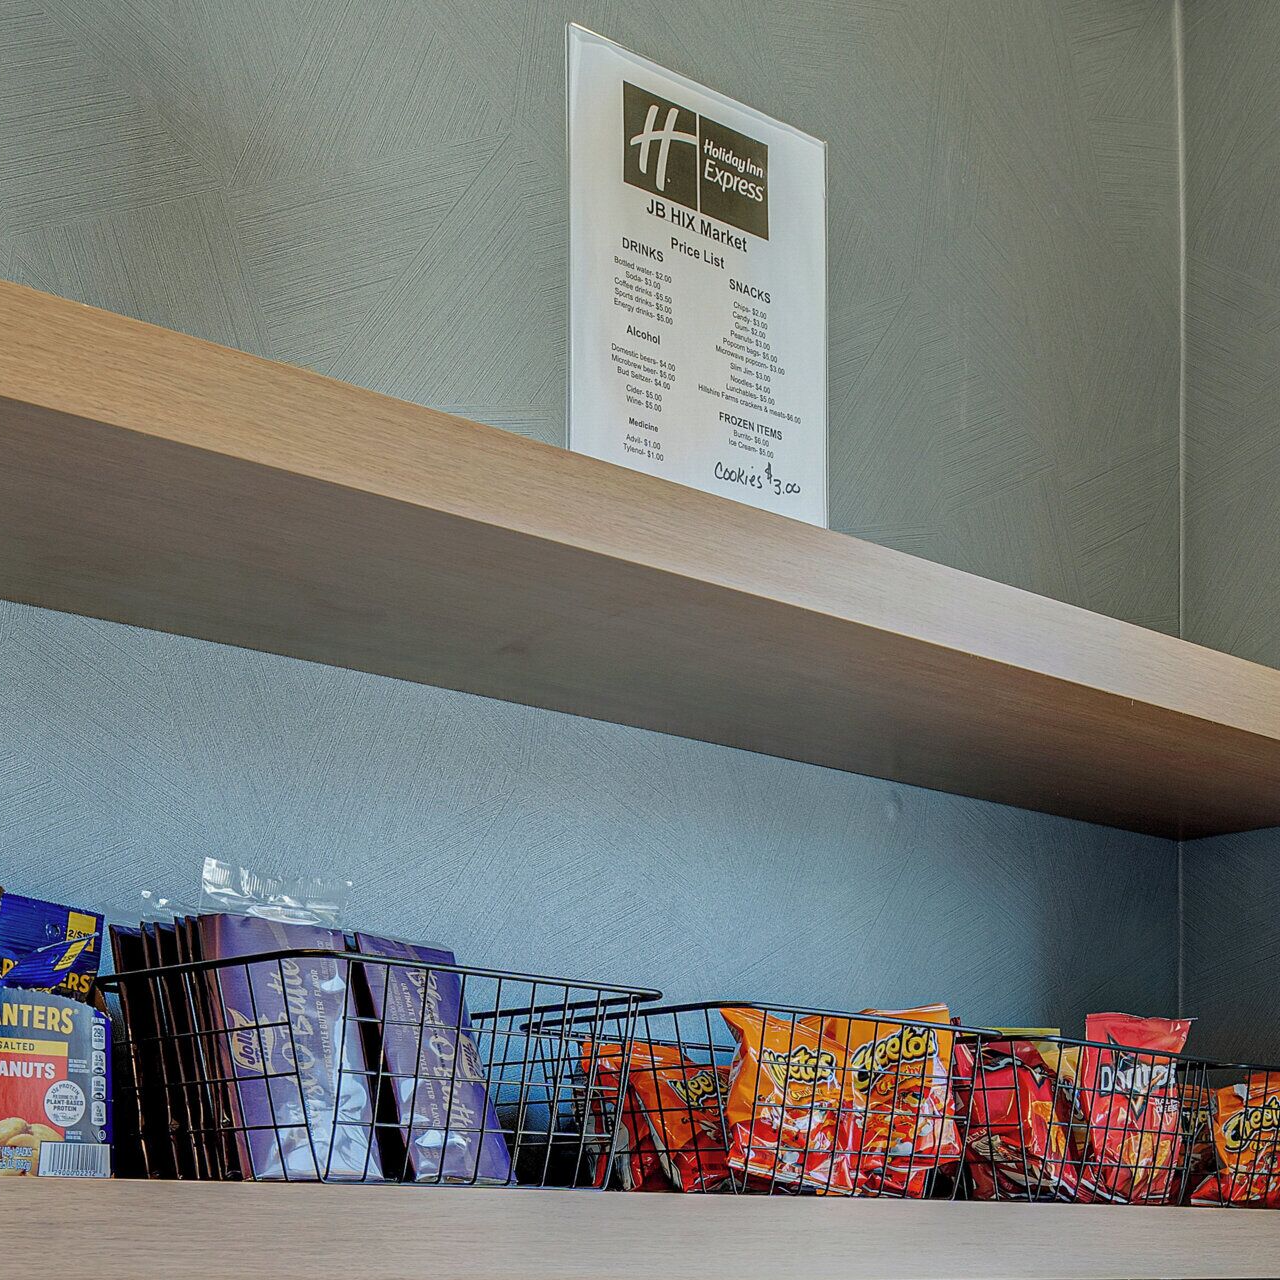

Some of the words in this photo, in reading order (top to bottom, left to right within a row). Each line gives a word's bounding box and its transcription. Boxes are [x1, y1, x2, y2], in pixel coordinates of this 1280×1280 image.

[703, 139, 746, 173] Holiday
[746, 158, 764, 178] Inn
[704, 159, 764, 201] Express
[646, 199, 665, 219] JB
[671, 207, 695, 232] HIX
[700, 219, 747, 252] Market
[622, 236, 664, 262] DRINKS
[671, 237, 700, 259] Price
[704, 250, 725, 269] List
[614, 255, 635, 270] Bottled
[655, 271, 672, 284] $2.00
[625, 271, 643, 282] Soda-
[644, 277, 661, 289] $3.00
[614, 277, 633, 290] Coffee
[635, 286, 652, 297] drinks
[729, 279, 771, 304] SNACKS
[614, 287, 634, 301] Sports
[655, 302, 672, 314] $5.00
[614, 297, 634, 313] Energy
[657, 313, 673, 325] $5.00
[752, 308, 767, 319] $2.00
[626, 324, 661, 345] Alcohol
[751, 328, 766, 339] $2.00
[753, 319, 768, 330] $3.00
[611, 342, 639, 359] Domestic
[659, 360, 676, 372] $4.00
[722, 337, 745, 352] Popcorn
[762, 352, 778, 363] $5.00
[755, 339, 770, 351] $3.00
[611, 354, 641, 370] Microbrew
[659, 370, 676, 381] $5.00
[715, 345, 745, 361] Microwave
[769, 364, 785, 375] $3.00
[730, 362, 742, 372] Slim
[755, 371, 771, 382] $3.00
[617, 366, 629, 376] Bud
[654, 378, 670, 390] $4.00
[755, 383, 771, 394] $4.00
[645, 400, 662, 412] $5.00
[646, 390, 662, 402] $5.00
[698, 383, 720, 397] Hillshire
[721, 392, 739, 404] Farms
[739, 399, 763, 411] crackers
[759, 394, 775, 405] $5.00
[629, 417, 659, 432] Medicine
[719, 411, 755, 432] FROZEN
[757, 423, 783, 441] ITEMS
[644, 438, 661, 450] $1.00
[647, 450, 664, 461] $1.00
[728, 438, 737, 446] Ice
[759, 448, 774, 458] $5.00
[714, 461, 762, 489] Cookies
[310, 969, 322, 997] FLAVOR
[400, 982, 416, 1018] ULTIMATE
[315, 1001, 329, 1029] BUTTER
[236, 1024, 257, 1066] Jolly
[320, 1030, 331, 1053] STYLE
[429, 1035, 456, 1062] O
[762, 1045, 836, 1092] heetos
[851, 1024, 938, 1092] Cheetos
[58, 1083, 80, 1096] PROTEIN
[1100, 1061, 1176, 1094] Doritos
[46, 1099, 84, 1107] PLANT-BASED
